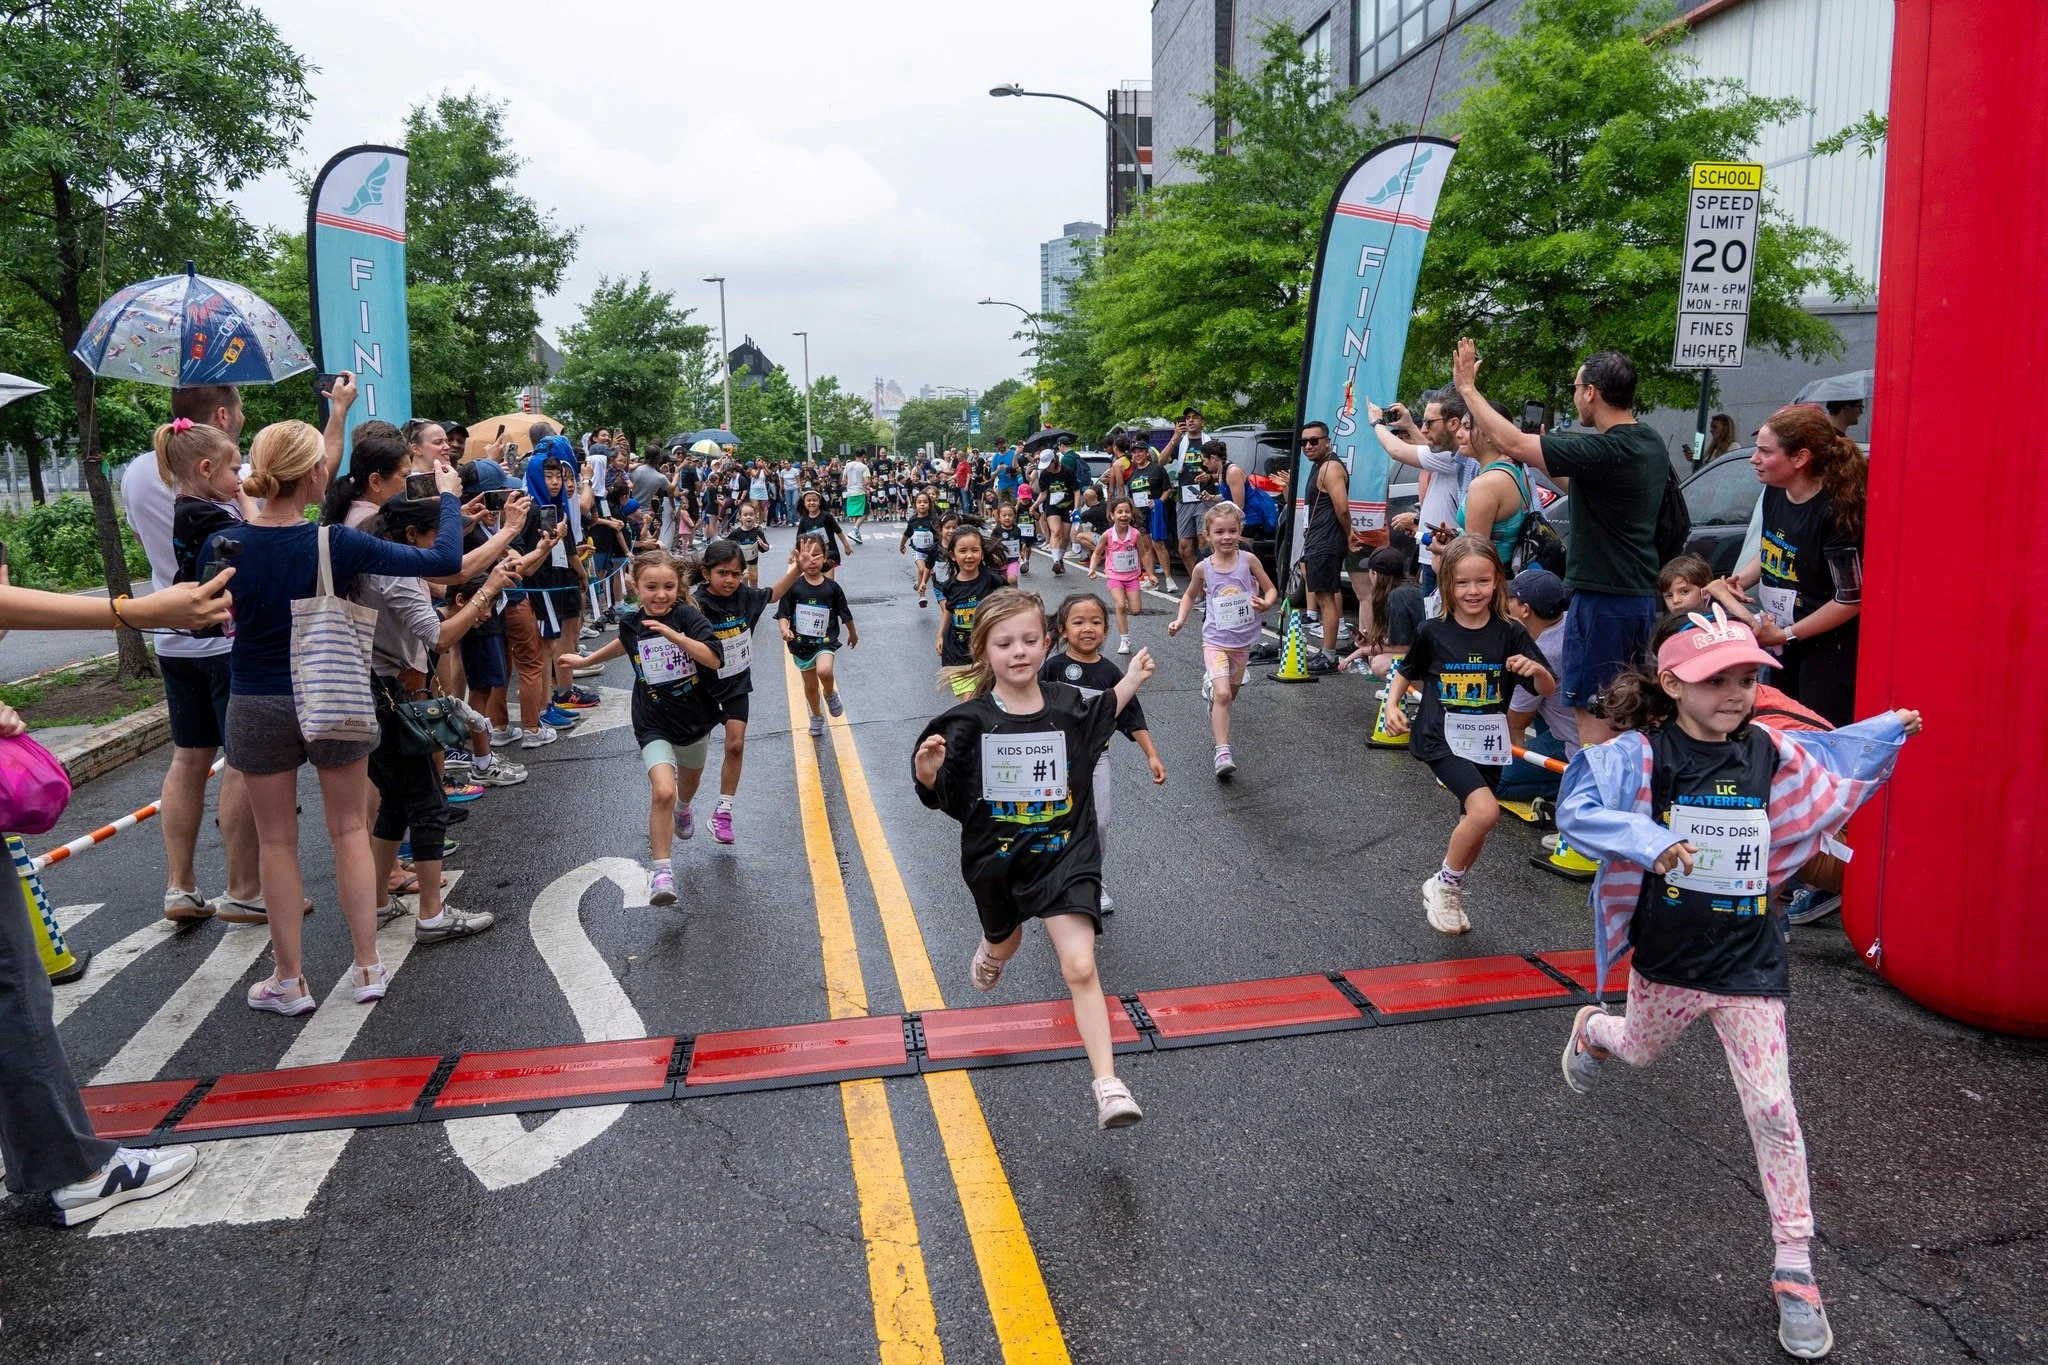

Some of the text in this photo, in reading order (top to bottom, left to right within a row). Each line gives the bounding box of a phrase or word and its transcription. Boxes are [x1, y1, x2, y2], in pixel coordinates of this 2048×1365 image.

[1698, 170, 1755, 186] SCHOOL
[1695, 195, 1754, 211] SPEED
[1700, 215, 1745, 230] LIMIT
[1690, 238, 1747, 274] 20
[1686, 282, 1710, 294] 7AM
[1722, 283, 1746, 295] 6PM
[1686, 299, 1712, 310] MON
[1724, 299, 1742, 310] FRI
[1690, 321, 1734, 337] FINES
[350, 257, 383, 417] FINI
[1681, 344, 1738, 359] HIGHER
[1238, 605, 1250, 618] #1
[813, 618, 824, 629] #1
[741, 644, 750, 659] #1
[1444, 663, 1503, 671] WATERFRONT
[1468, 656, 1483, 664] LIC
[1456, 723, 1500, 732] KIDS DASH
[1483, 734, 1503, 751] #1
[997, 745, 1054, 756] KIDS DASH
[1033, 759, 1056, 782] #1
[1715, 784, 1738, 796] LIC
[1678, 795, 1762, 808] WATERFRON
[1690, 824, 1760, 838] KIDS DASH
[1735, 844, 1760, 871] #1
